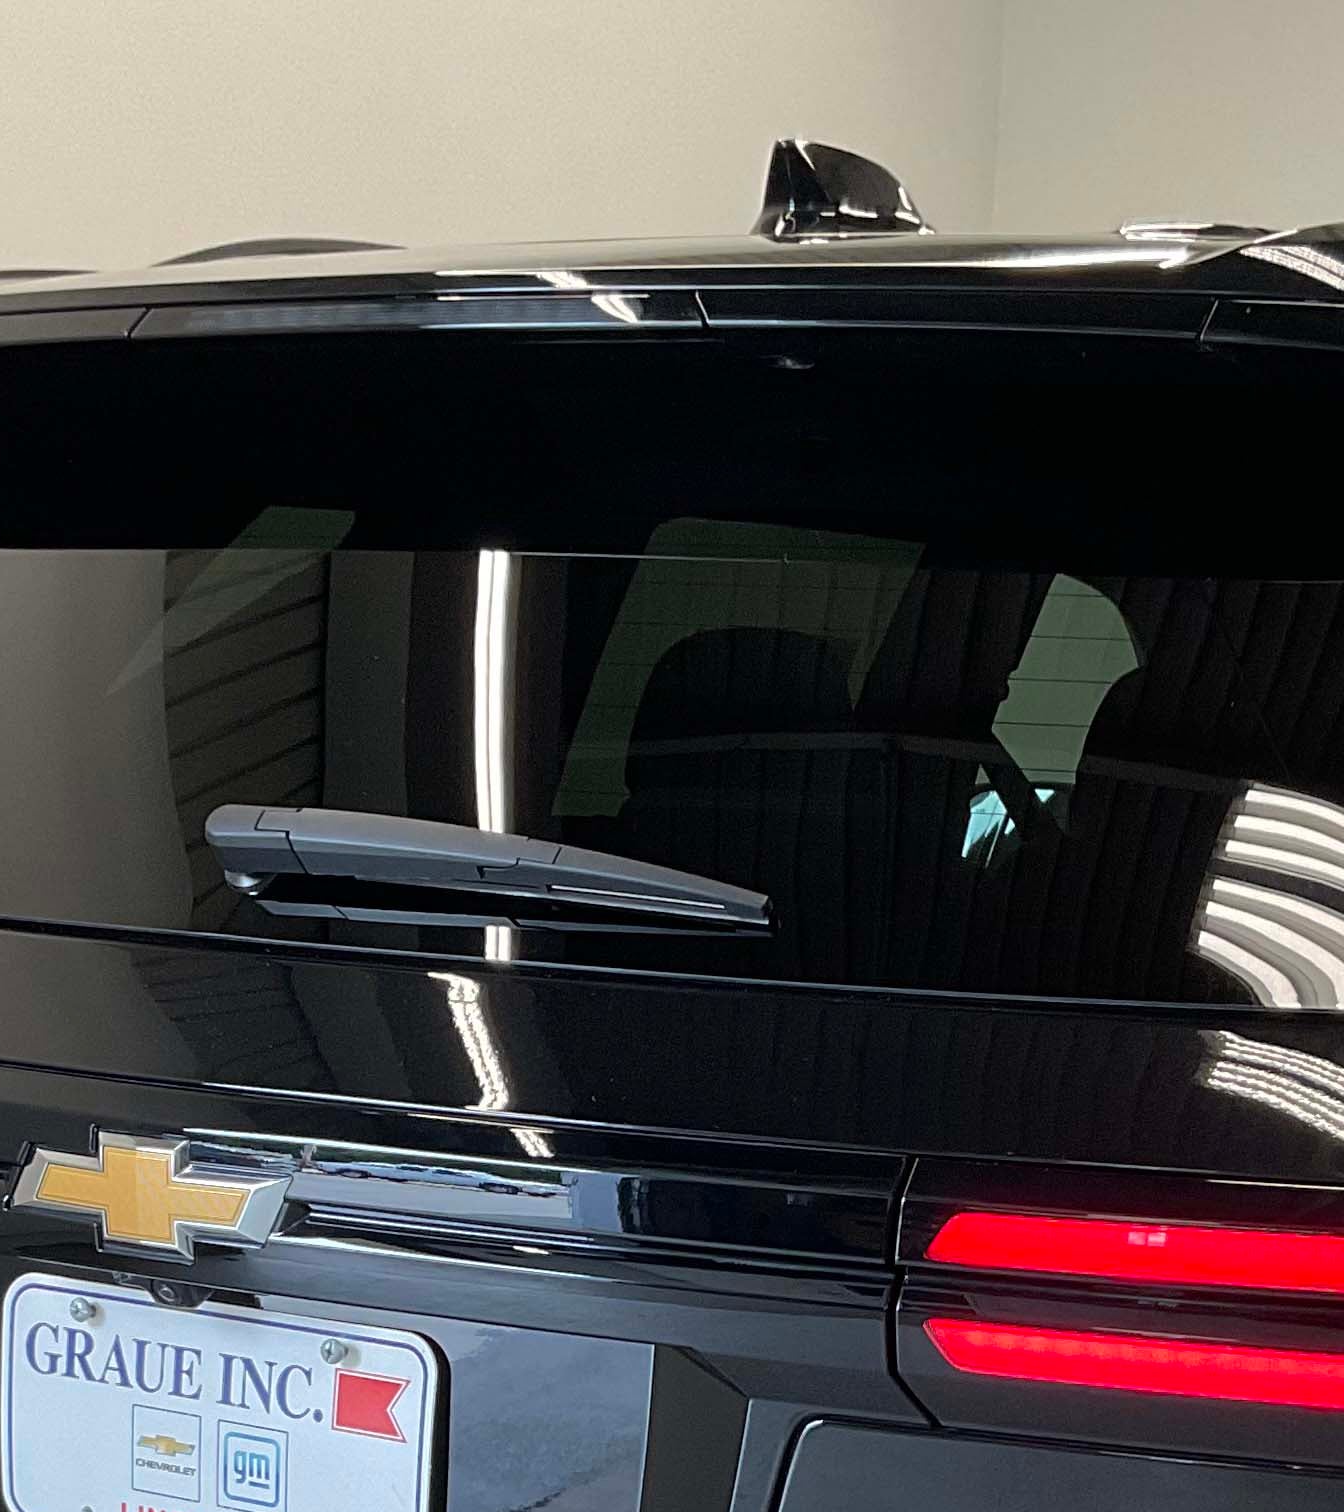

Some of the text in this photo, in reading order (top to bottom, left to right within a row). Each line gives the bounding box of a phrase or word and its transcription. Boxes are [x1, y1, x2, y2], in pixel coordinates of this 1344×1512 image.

[25, 1322, 323, 1423] GRAUE INC.
[135, 1457, 197, 1478] CHEVROLET
[234, 1449, 270, 1486] gm
